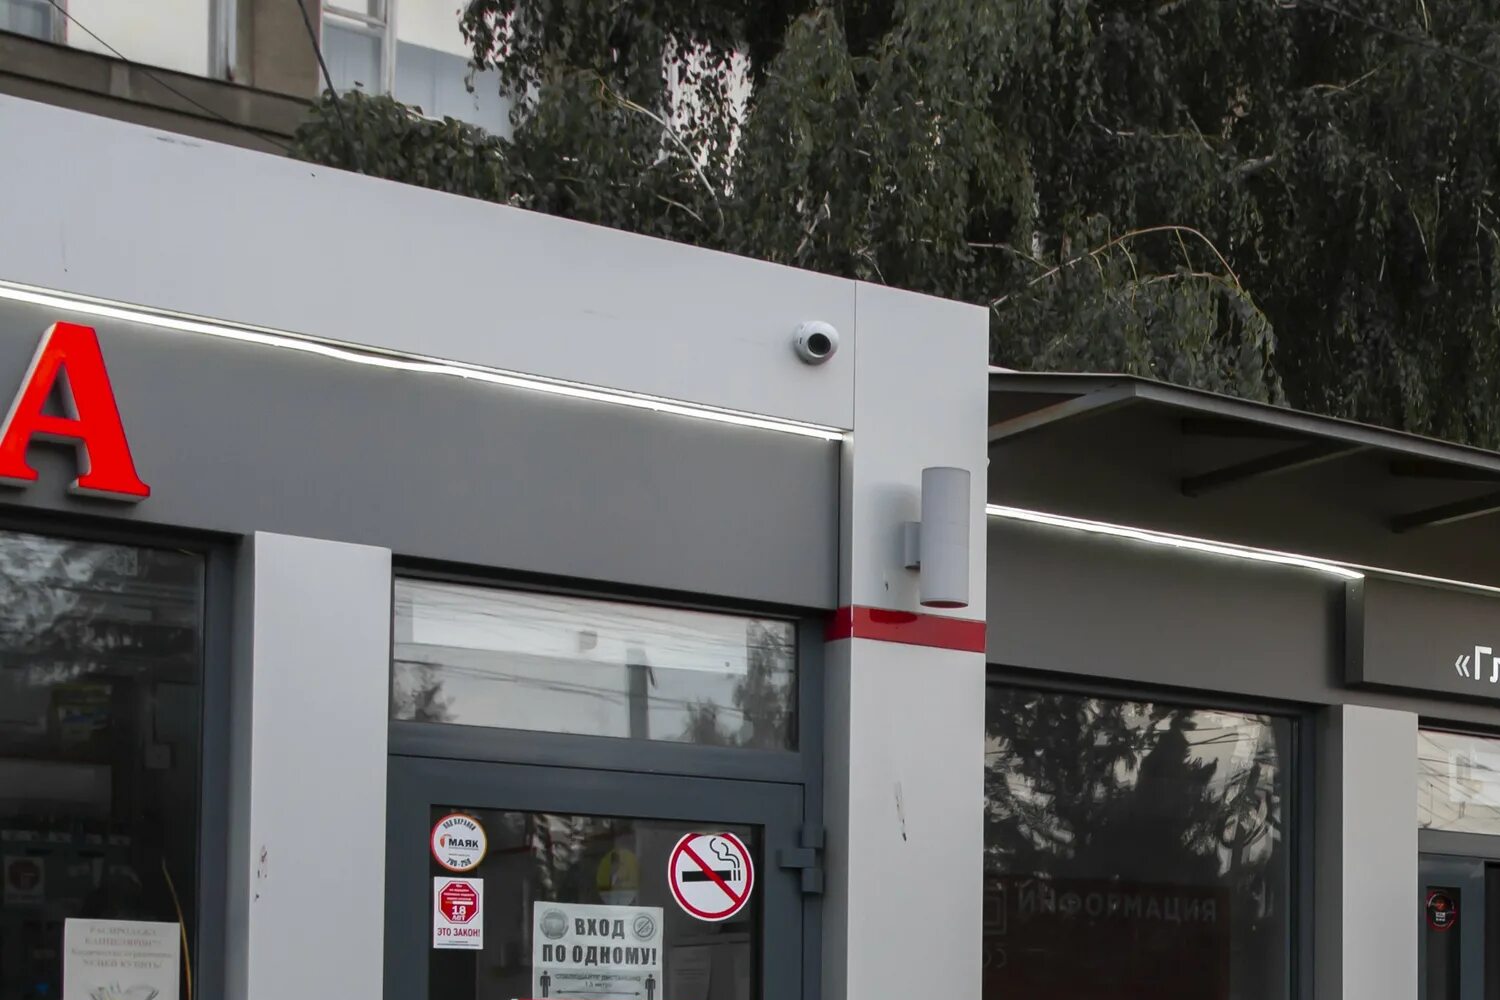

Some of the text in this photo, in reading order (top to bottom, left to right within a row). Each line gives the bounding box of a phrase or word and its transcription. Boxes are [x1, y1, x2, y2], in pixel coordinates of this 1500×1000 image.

[448, 838, 479, 848] МАЯК
[452, 905, 466, 915] 18
[1017, 888, 1217, 922] ИНФОРМАЦИЯ
[437, 927, 480, 937] ЭТО ЗАКОН!
[574, 917, 625, 939] ВХОД
[542, 944, 657, 966] ПО ОДНОМУ!
